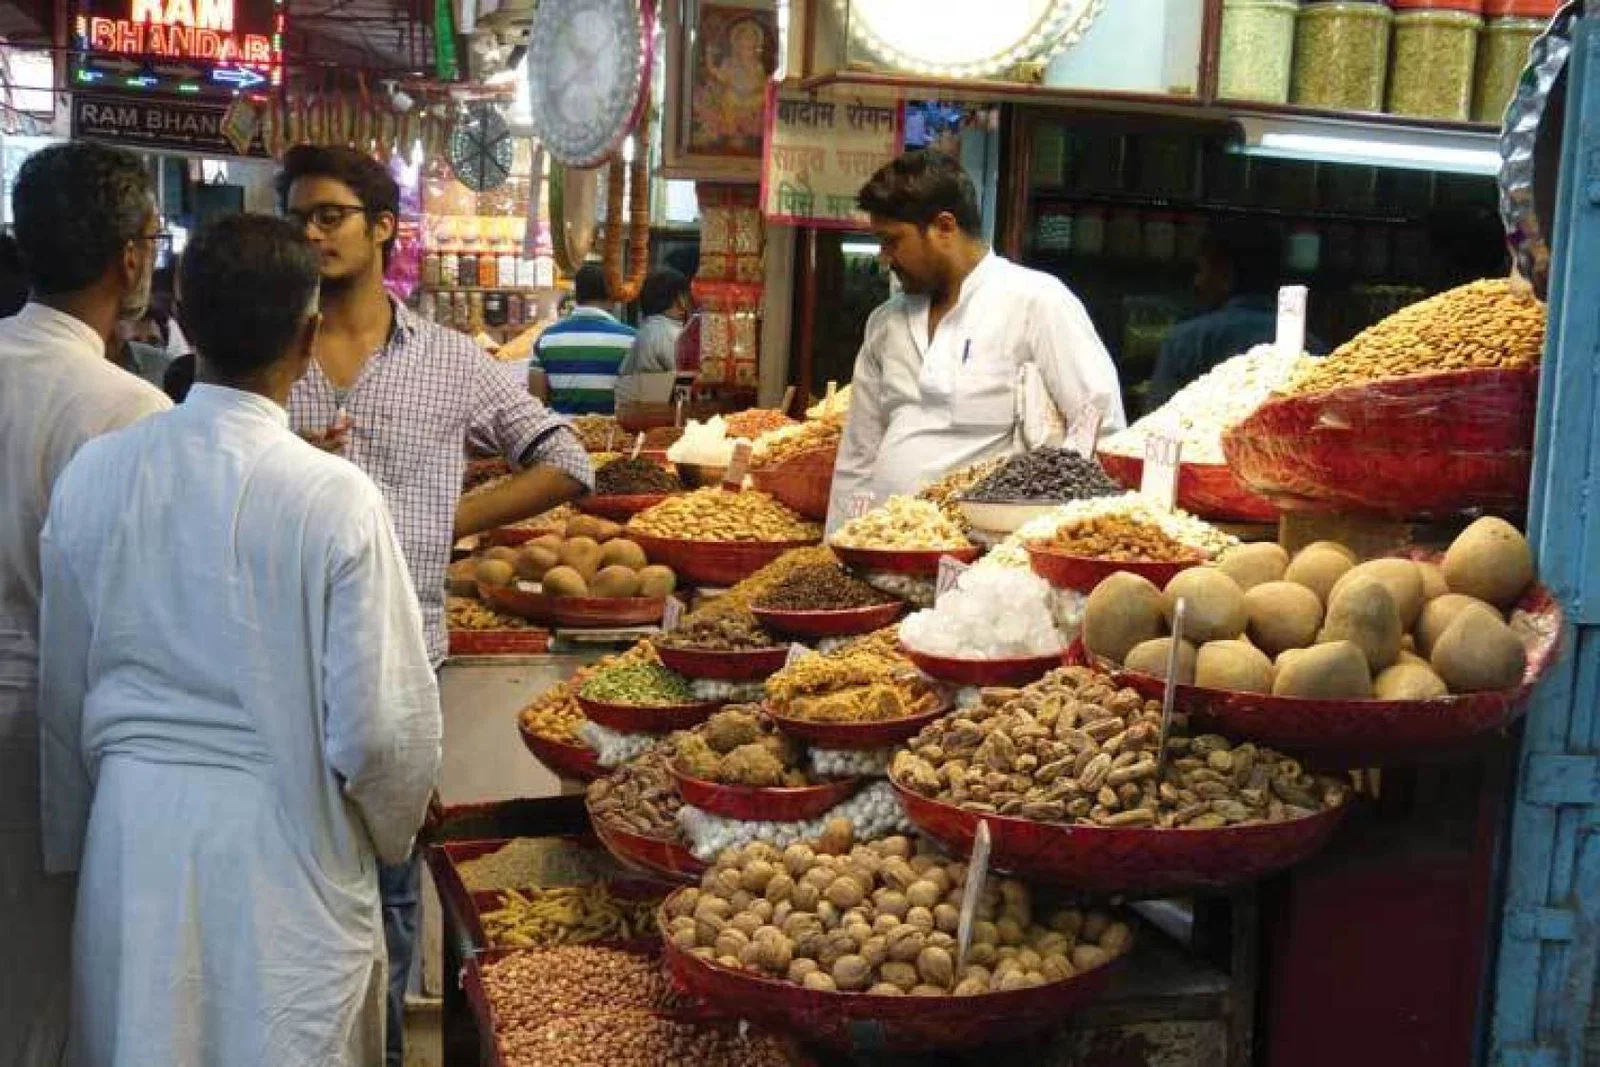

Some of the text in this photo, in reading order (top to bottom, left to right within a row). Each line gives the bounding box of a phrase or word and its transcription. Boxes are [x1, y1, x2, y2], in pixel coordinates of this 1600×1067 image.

[132, 0, 234, 30] RAM
[91, 16, 270, 62] BHANDAR
[80, 103, 138, 127] RAM
